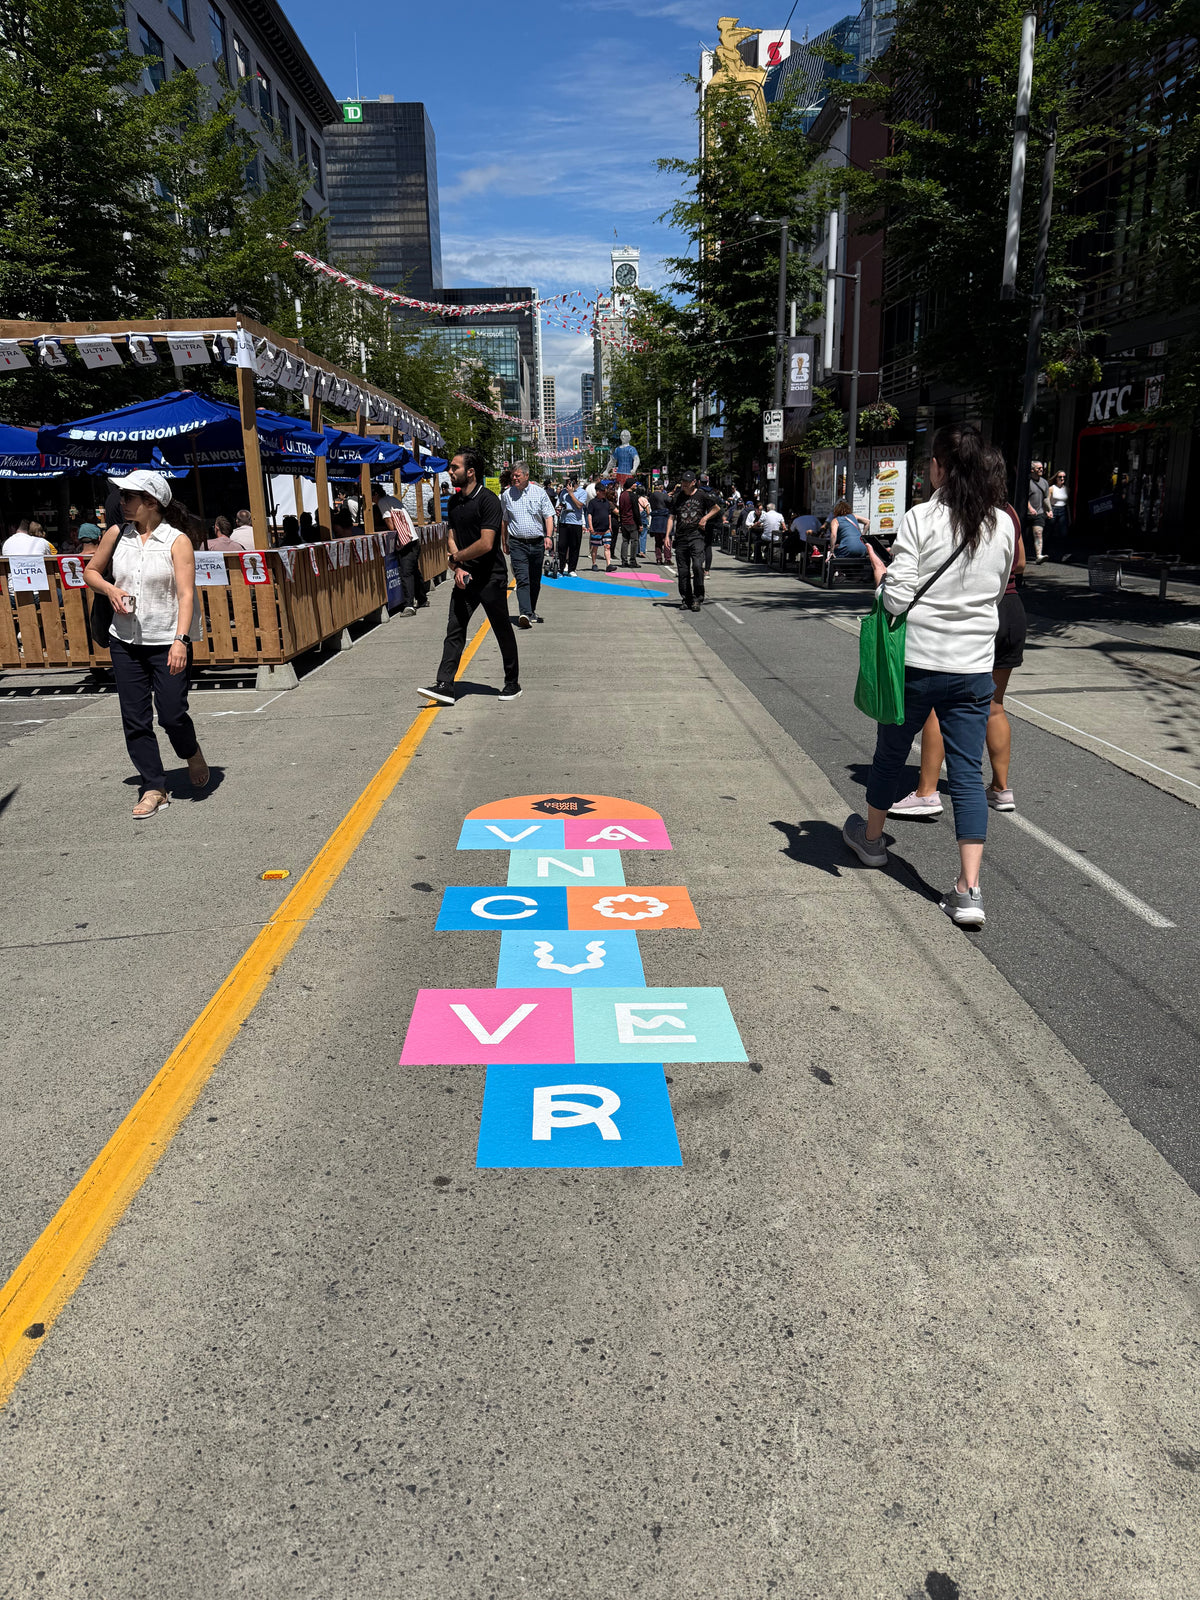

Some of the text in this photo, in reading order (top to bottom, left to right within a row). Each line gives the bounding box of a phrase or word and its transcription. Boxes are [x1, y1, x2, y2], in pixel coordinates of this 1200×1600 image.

[344, 106, 361, 120] TD
[82, 347, 113, 355] ULTRA
[1088, 385, 1132, 422] KFC
[180, 420, 207, 433] FIFA
[98, 431, 127, 441] CUP
[129, 430, 177, 442] WORLD
[109, 448, 138, 460] ULTRA
[285, 440, 315, 456] ULTRA
[329, 449, 363, 460] ULTRA
[872, 446, 905, 458] TOWN
[209, 450, 244, 461] WORL
[855, 459, 895, 470] OT DOG
[484, 825, 543, 843] V
[536, 856, 596, 877] N
[470, 895, 539, 920] C
[449, 1002, 697, 1045] V E
[531, 1084, 622, 1141] R
